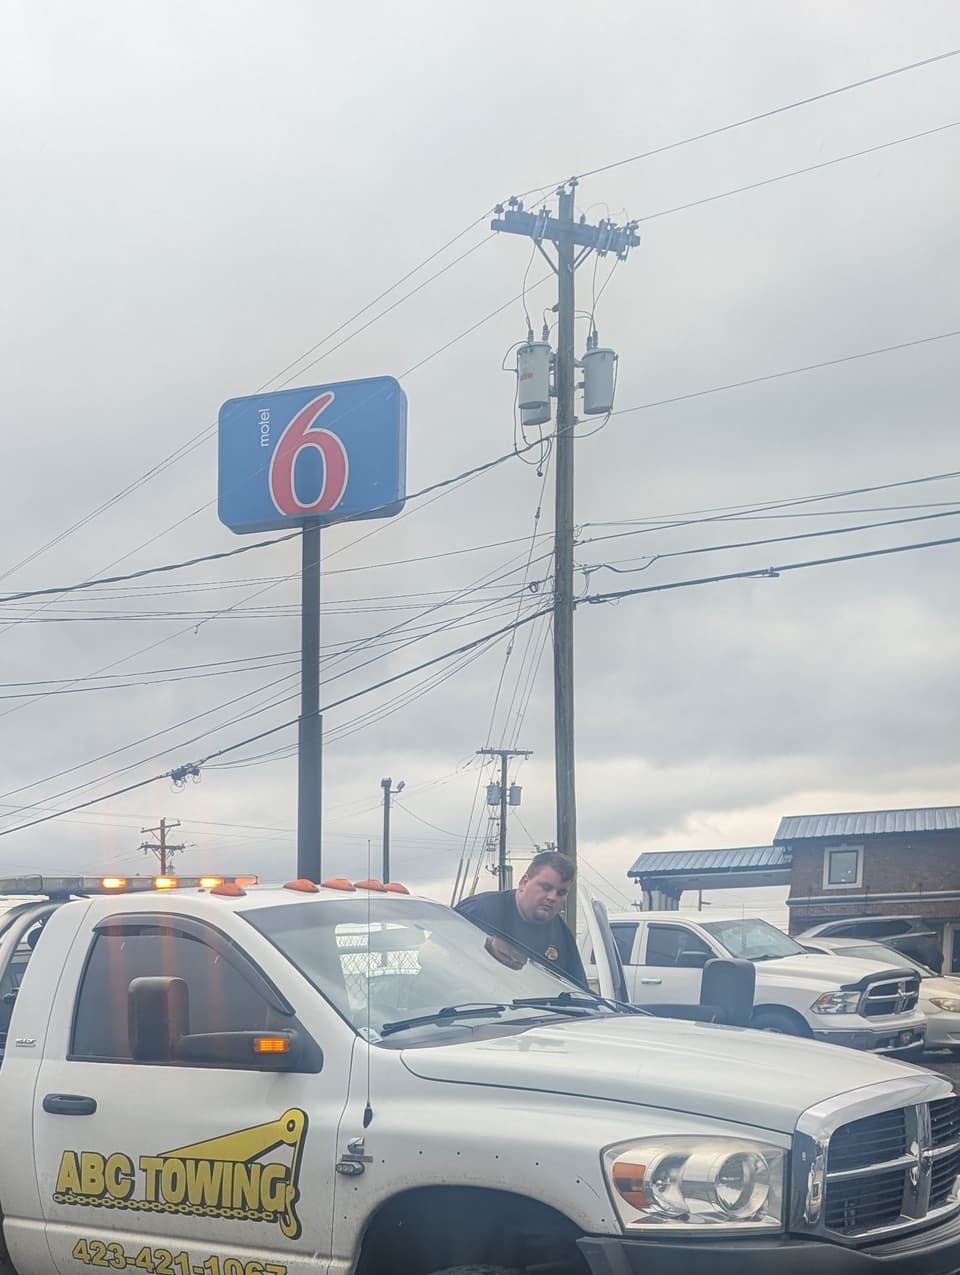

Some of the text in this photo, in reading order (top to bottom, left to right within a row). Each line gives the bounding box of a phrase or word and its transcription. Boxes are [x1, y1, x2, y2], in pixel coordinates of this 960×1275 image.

[258, 408, 271, 447] motel
[269, 391, 350, 516] 6
[55, 1151, 291, 1213] ABC TOWING
